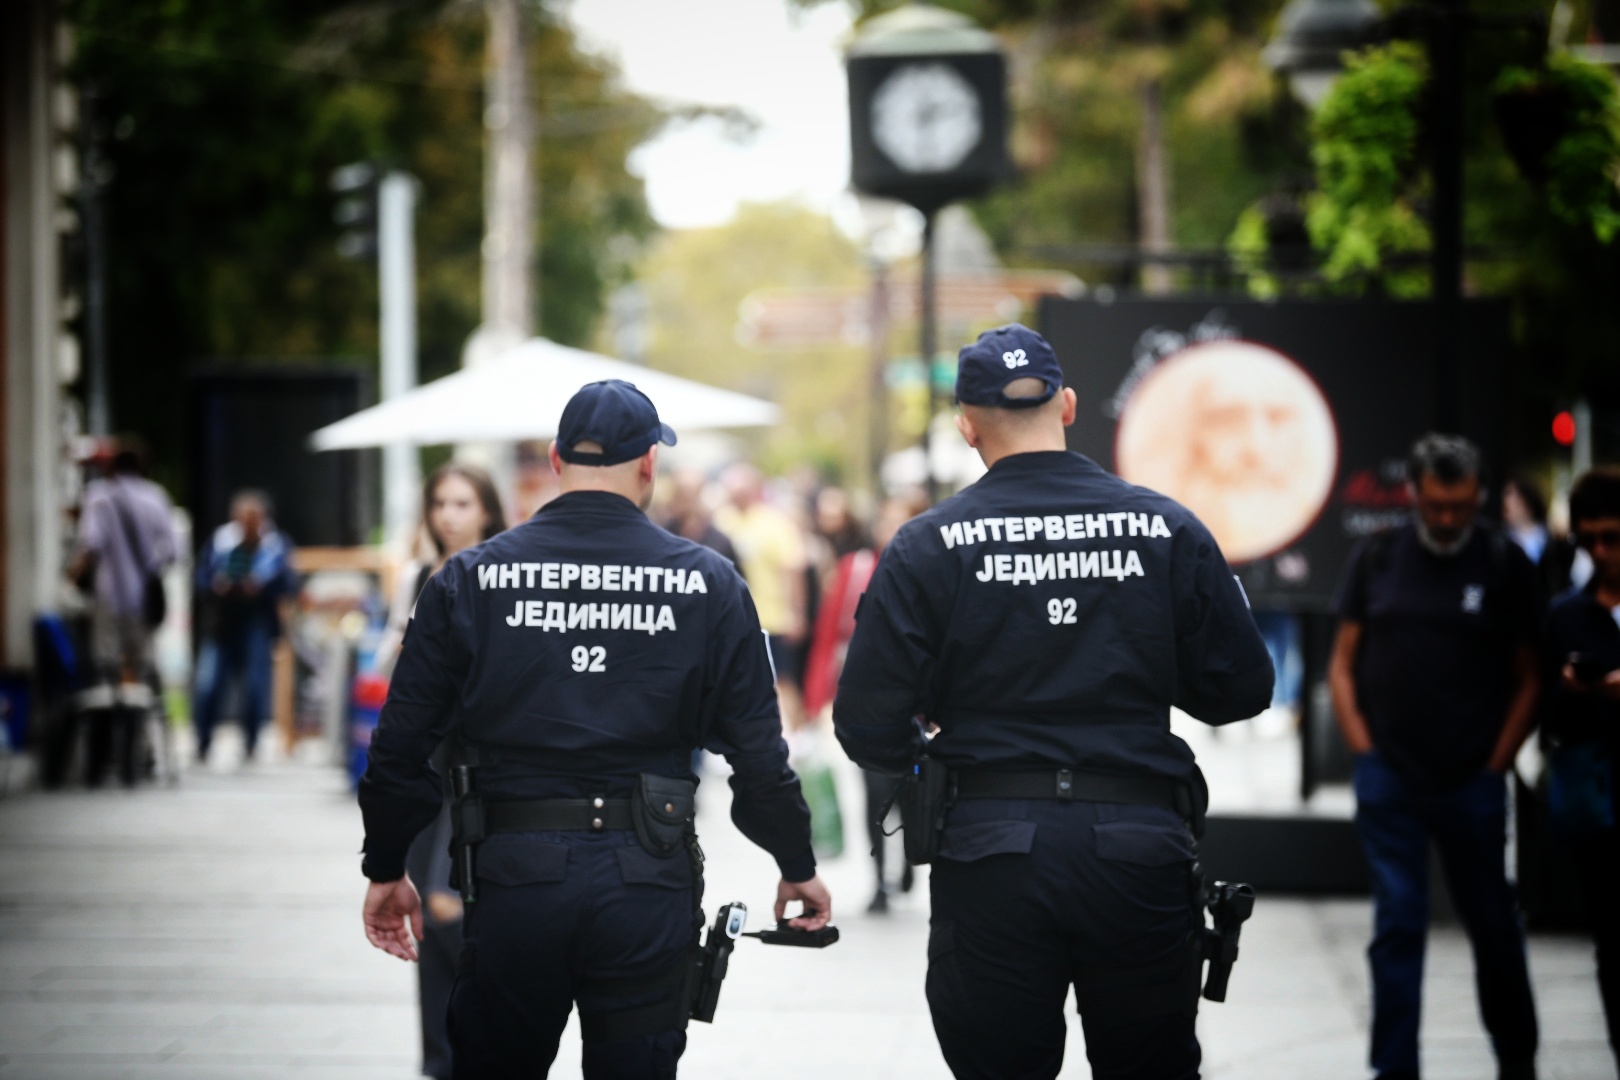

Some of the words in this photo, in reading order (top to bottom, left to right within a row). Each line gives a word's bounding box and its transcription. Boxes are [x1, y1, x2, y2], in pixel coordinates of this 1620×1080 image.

[1002, 348, 1029, 370] 92
[940, 512, 1172, 550] ИНТЕРВЕНТНА
[477, 562, 708, 594] ИНТЕРВЕНТНА
[975, 550, 1145, 586] ЈЕДИНИЦА
[505, 600, 677, 635] ЈЕДИНИЦА
[1047, 597, 1078, 625] 92
[571, 645, 607, 673] 92
